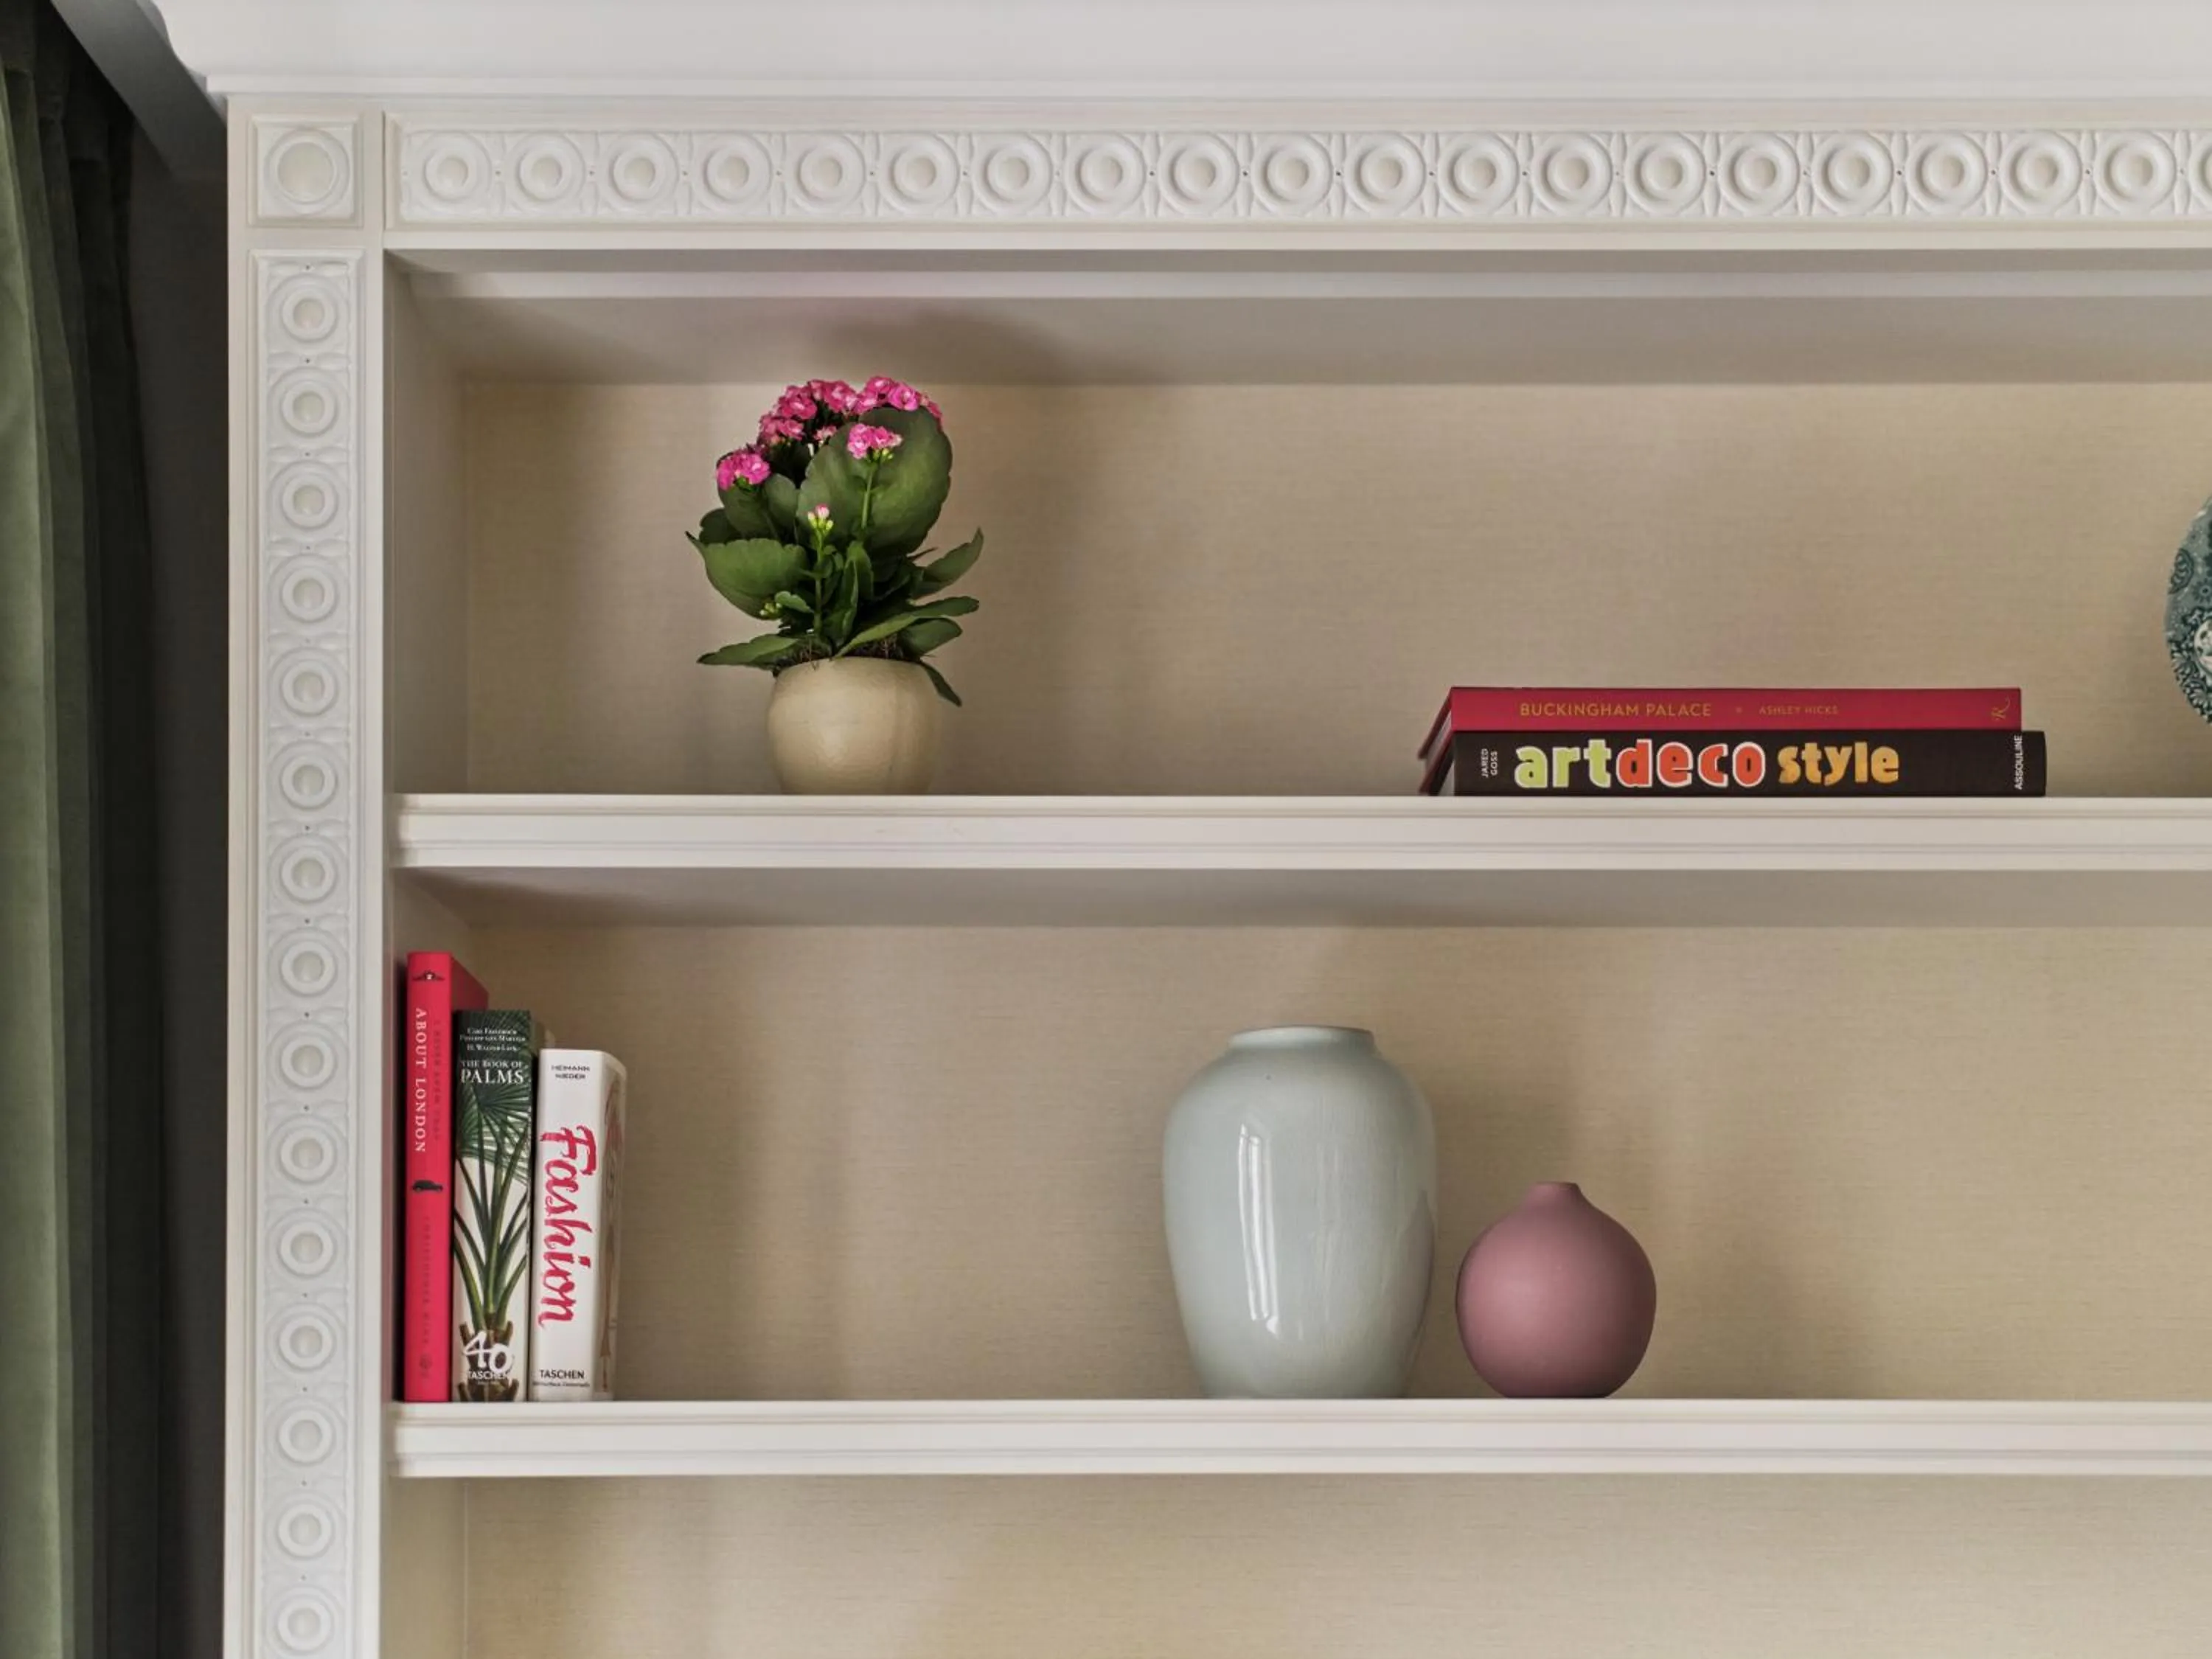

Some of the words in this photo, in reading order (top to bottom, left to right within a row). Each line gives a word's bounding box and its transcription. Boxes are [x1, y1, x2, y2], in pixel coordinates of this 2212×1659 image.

[1520, 703, 1639, 717] BUCKINGHAM
[1646, 703, 1711, 717] PALACE
[1759, 705, 1801, 715] ASHLEY
[1804, 705, 1839, 715] HICKS
[1480, 748, 1489, 778] JARED
[1489, 751, 1498, 776] GOSS
[1777, 741, 1900, 786] style
[2014, 735, 2024, 790] ASSOULINE
[414, 1007, 428, 1068] ABOUT
[460, 1068, 524, 1084] PALMS
[483, 1060, 508, 1068] BOOK
[414, 1078, 428, 1152] LONDON
[538, 1124, 597, 1329] Fashion
[463, 1331, 514, 1374] 40
[540, 1369, 585, 1380] TASCHEN
